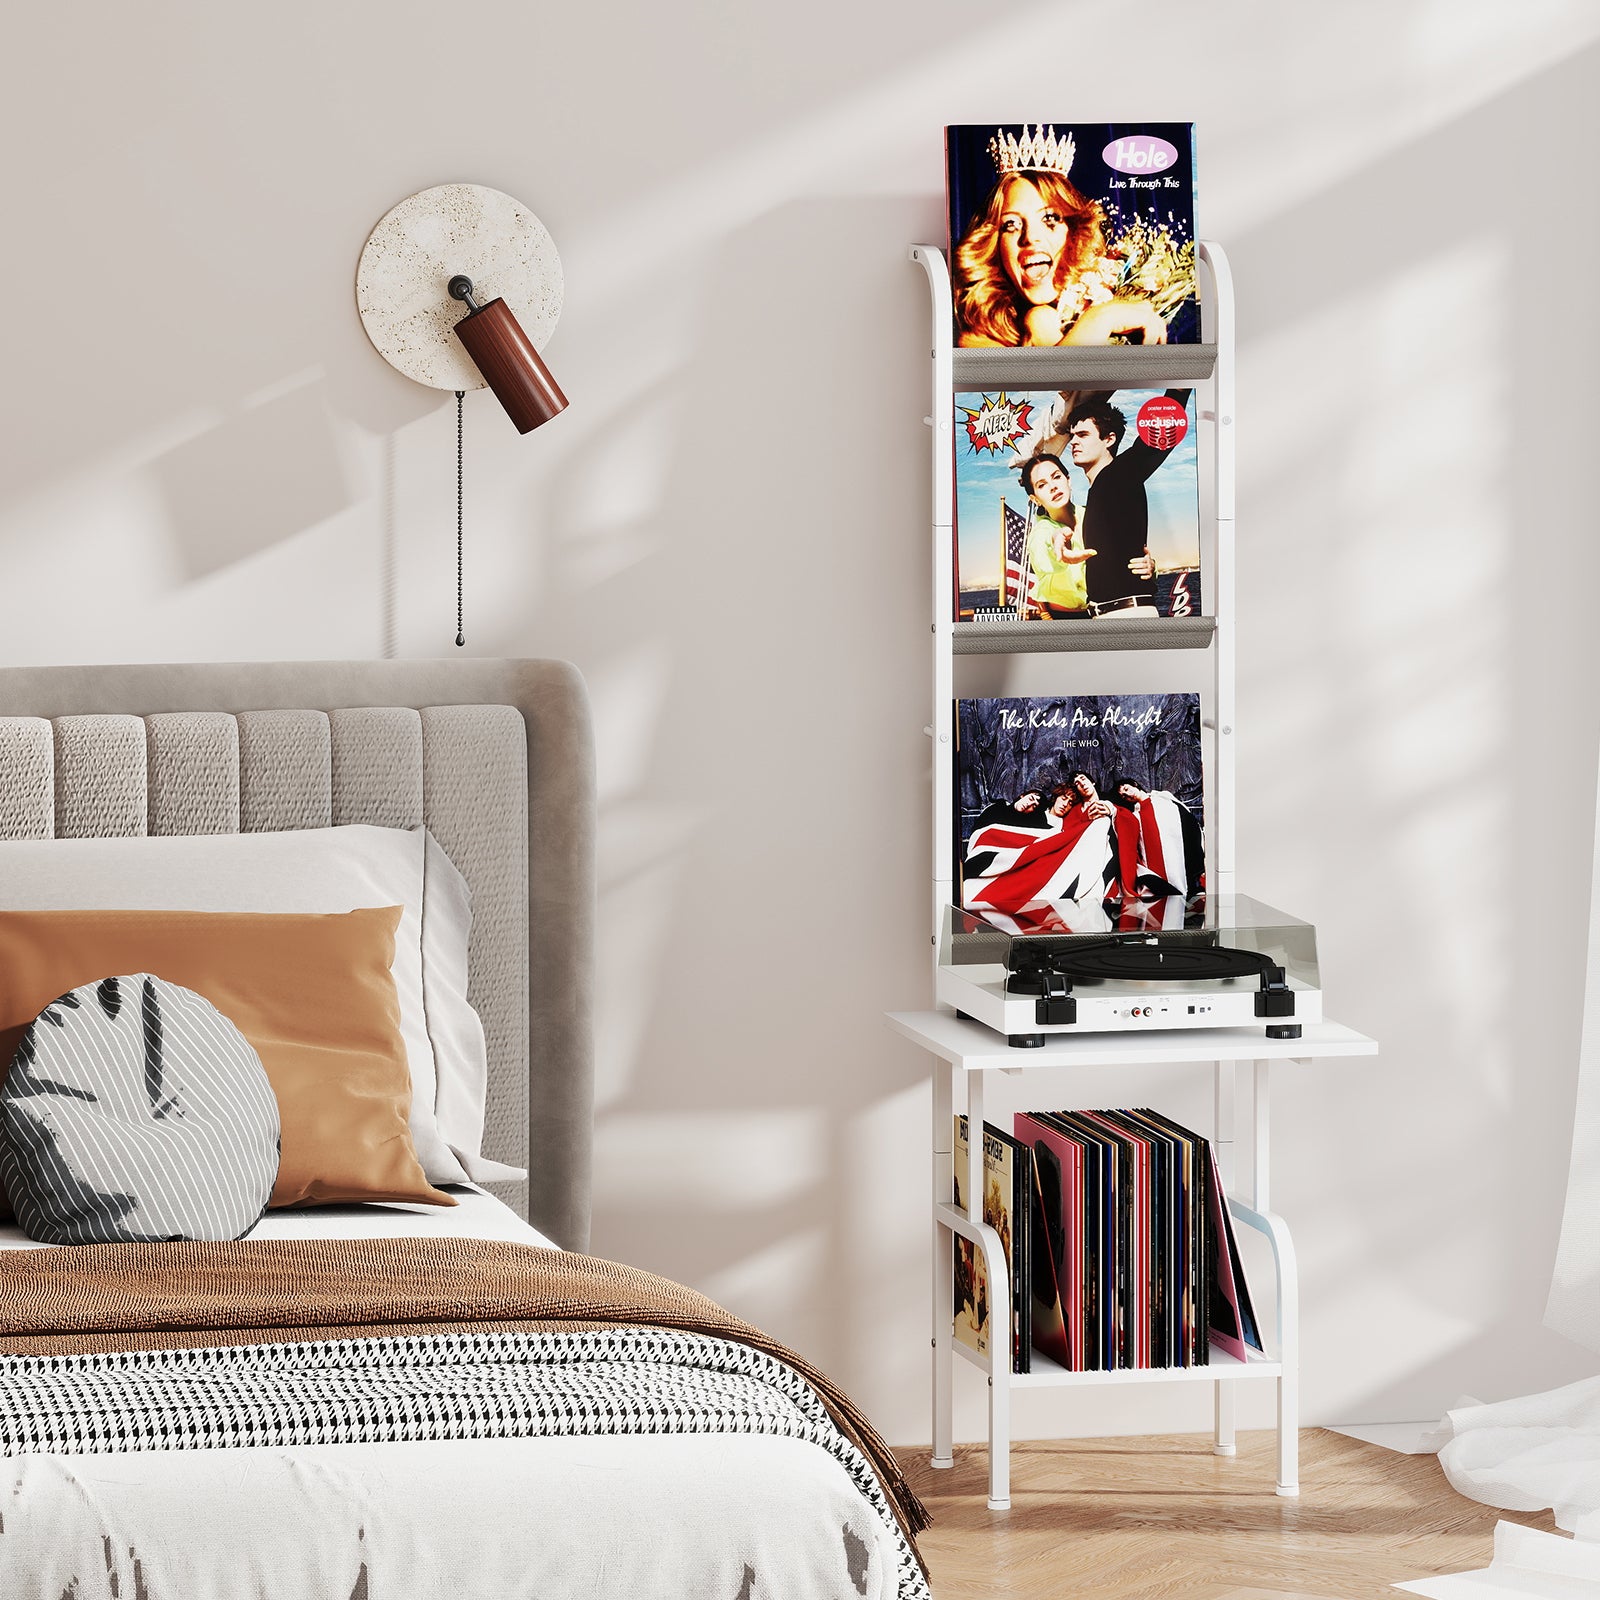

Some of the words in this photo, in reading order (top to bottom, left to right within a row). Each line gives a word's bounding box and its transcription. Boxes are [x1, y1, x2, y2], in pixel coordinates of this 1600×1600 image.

[1115, 141, 1168, 168] Hole
[1109, 177, 1127, 189] Live
[1128, 176, 1162, 190] Through
[1163, 176, 1180, 188] This
[1138, 416, 1186, 427] exclusive
[976, 614, 1016, 622] ADVISORY
[999, 709, 1024, 729] The
[1028, 708, 1068, 729] Kids
[1071, 706, 1098, 728] Are
[1102, 705, 1162, 733] Alright
[1062, 740, 1077, 748] THE
[1079, 739, 1099, 748] WHO
